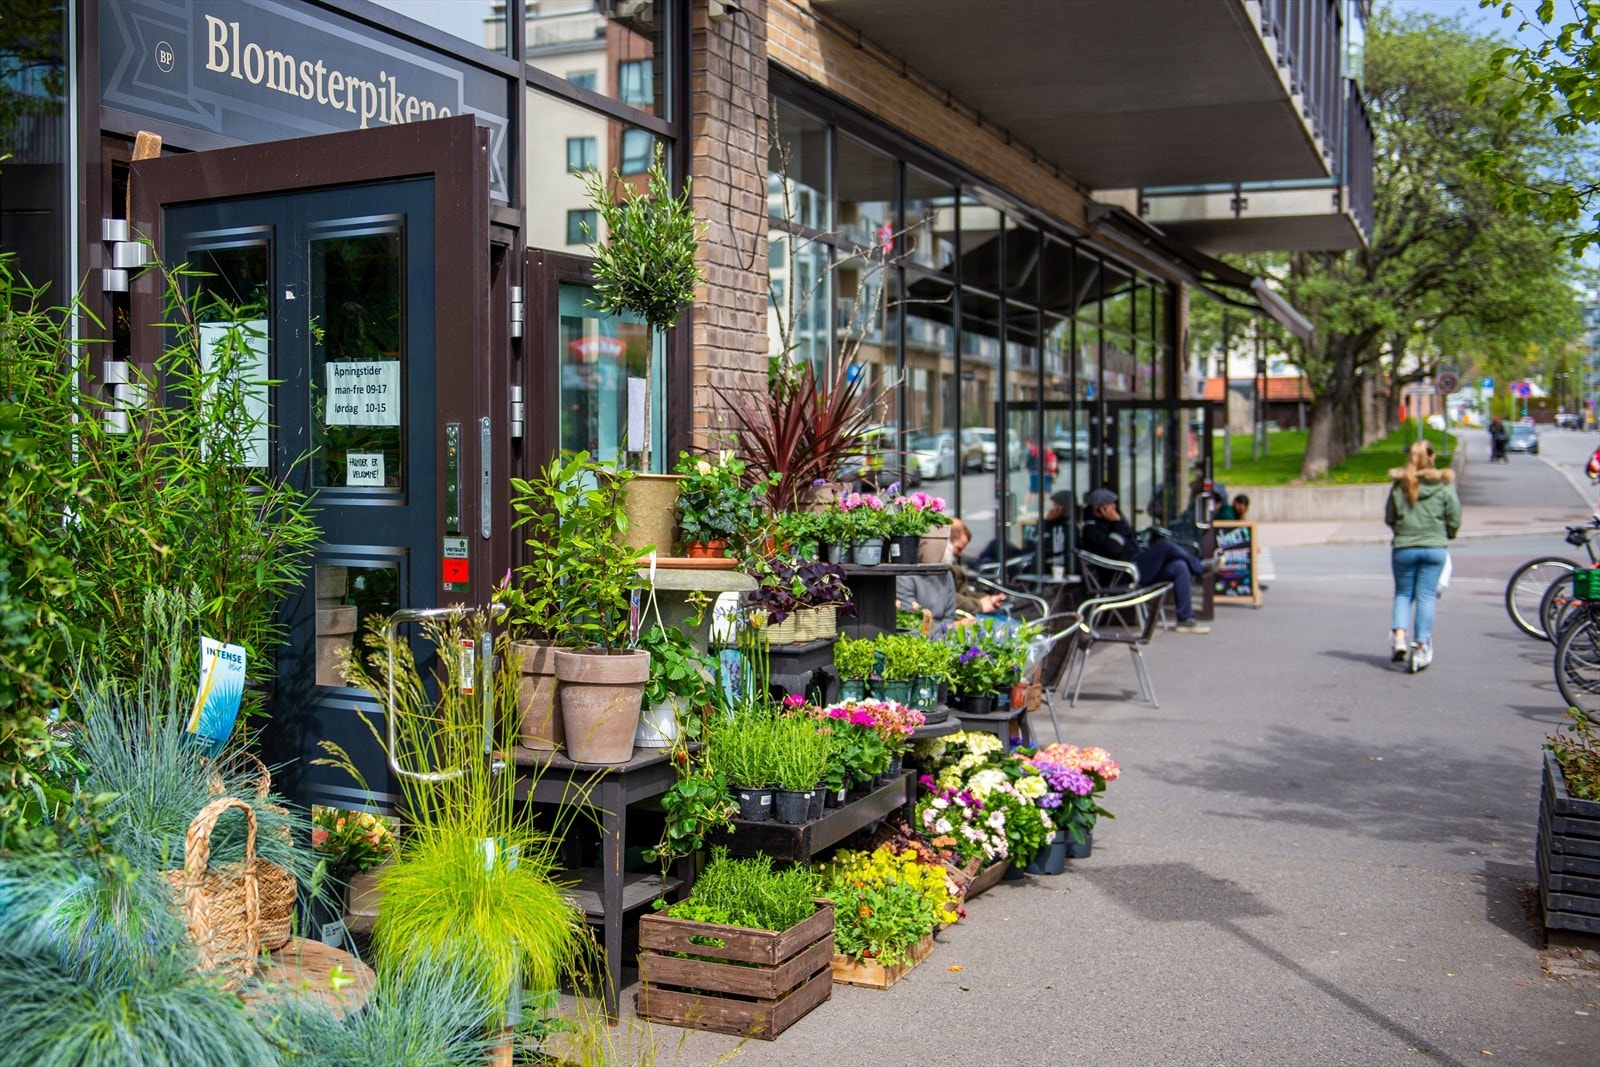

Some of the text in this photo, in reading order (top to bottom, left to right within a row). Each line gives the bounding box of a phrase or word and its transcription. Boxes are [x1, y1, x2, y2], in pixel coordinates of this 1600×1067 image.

[160, 50, 172, 65] BP
[334, 364, 382, 378] Åpningstider
[334, 384, 387, 395] man-fre 09-17
[334, 403, 386, 415] lørdag 10-15
[371, 458, 378, 467] ER
[206, 647, 242, 664] INTENSE
